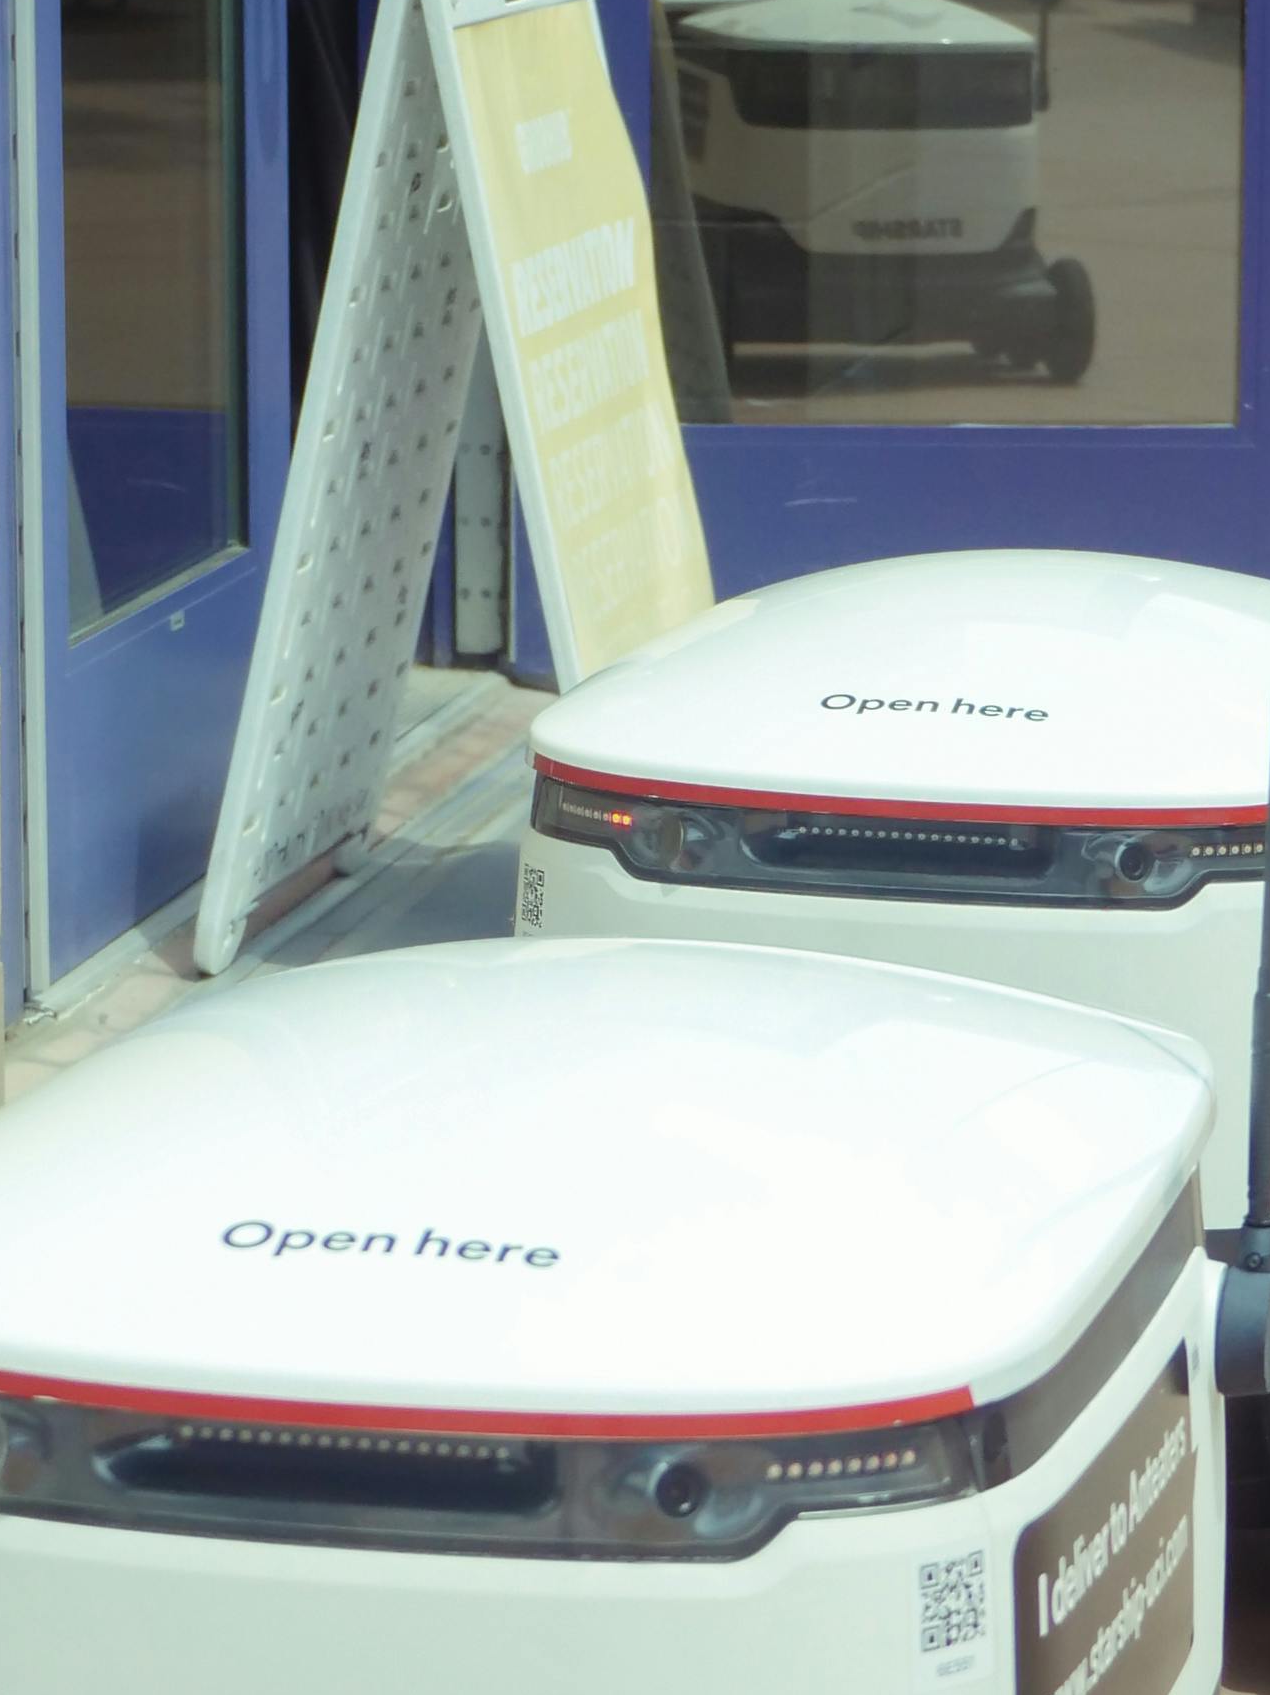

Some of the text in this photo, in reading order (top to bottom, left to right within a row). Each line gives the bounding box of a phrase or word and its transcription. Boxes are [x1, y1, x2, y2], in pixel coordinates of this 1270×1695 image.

[511, 216, 636, 338] RESERVATION
[530, 308, 650, 434] RESERVATION
[820, 693, 1050, 723] Open here
[222, 1219, 561, 1269] Open here
[1038, 1572, 1049, 1637] I
[1051, 1522, 1109, 1625] deliver
[1110, 1502, 1128, 1555] to
